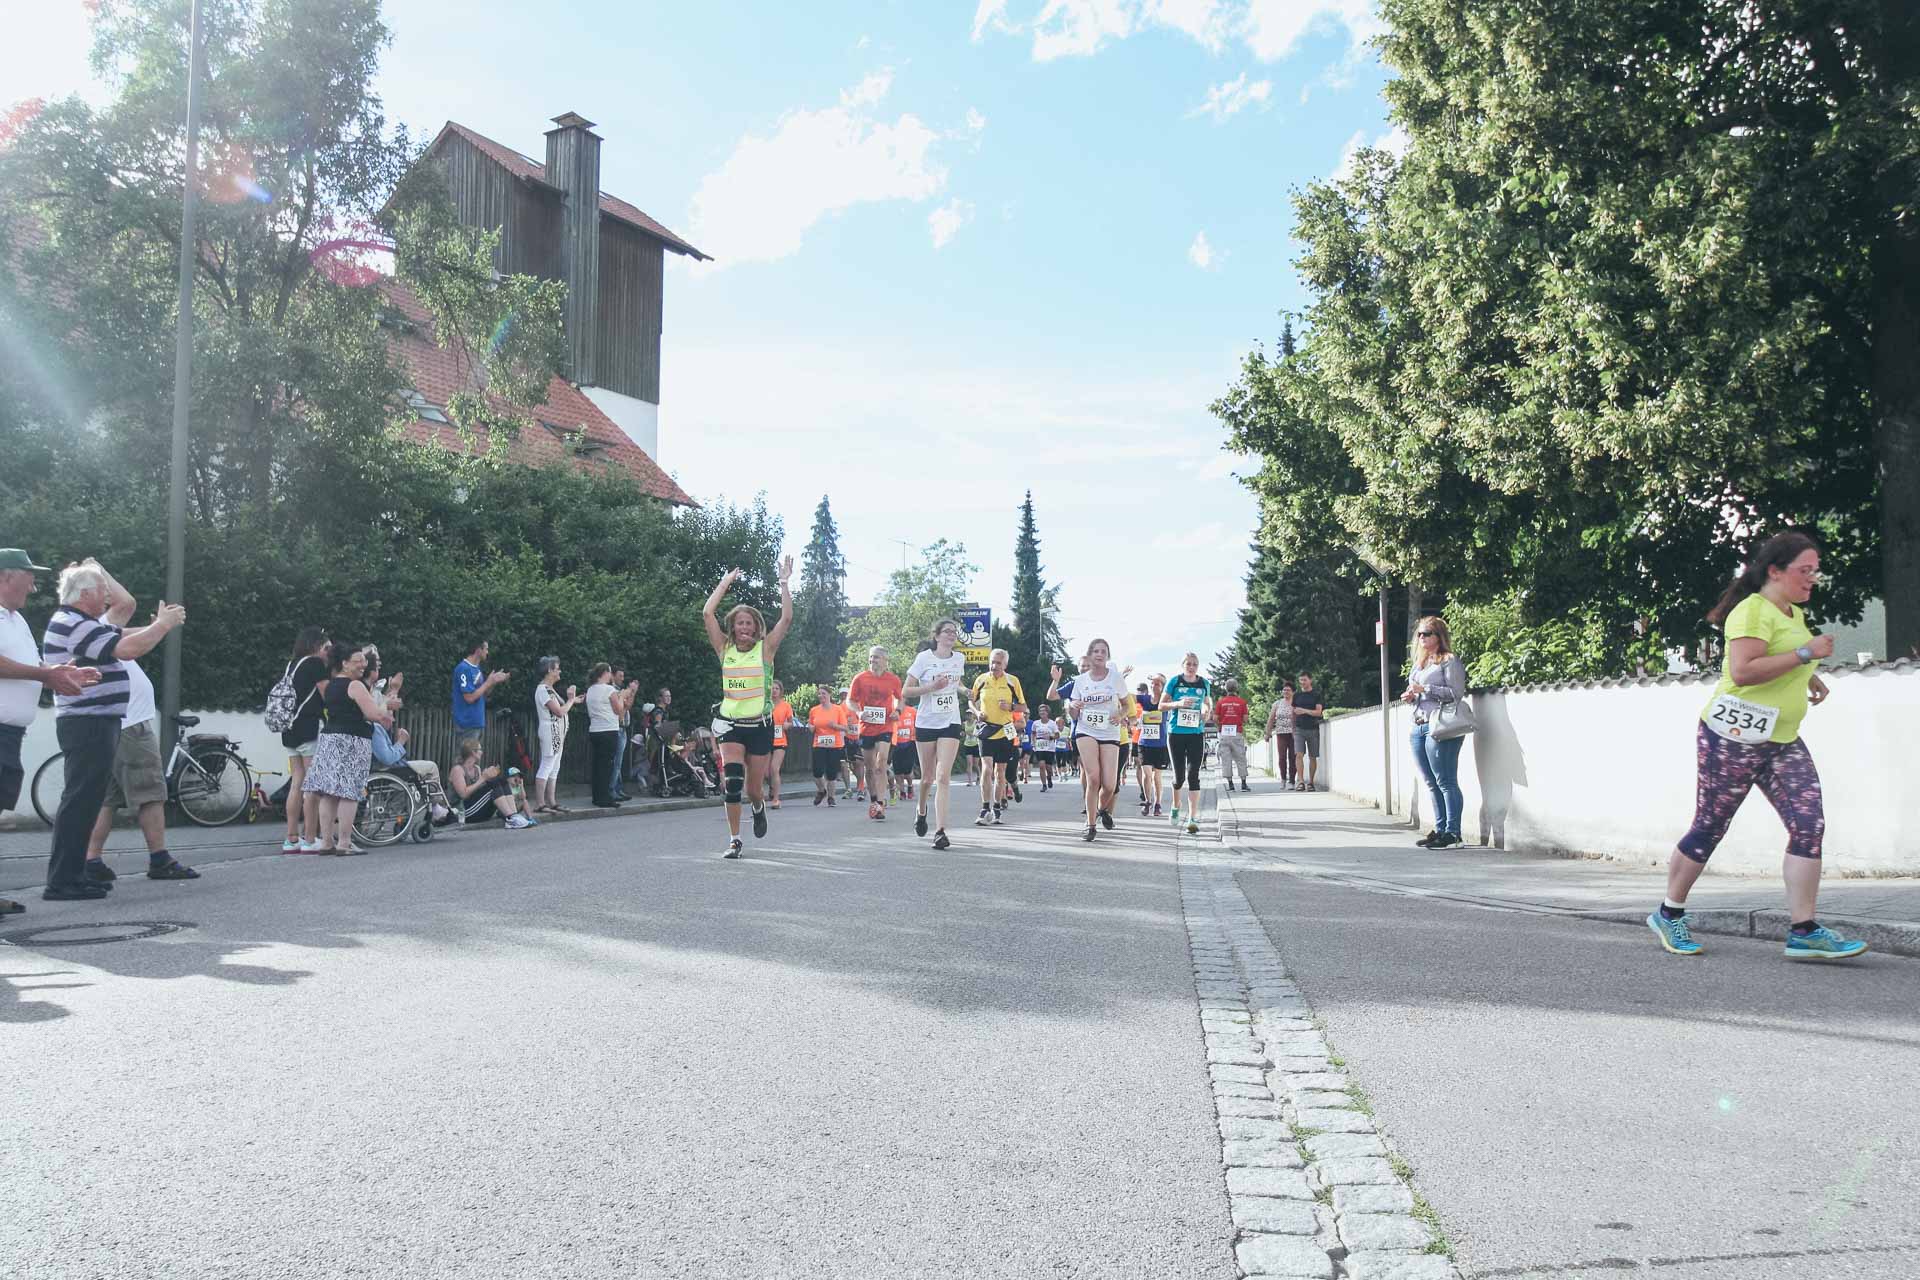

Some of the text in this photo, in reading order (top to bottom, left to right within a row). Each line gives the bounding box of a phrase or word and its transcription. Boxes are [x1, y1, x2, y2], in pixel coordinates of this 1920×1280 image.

[937, 696, 953, 705] 640
[869, 711, 884, 719] 398
[1087, 714, 1104, 723] 633
[1712, 704, 1768, 733] 2534
